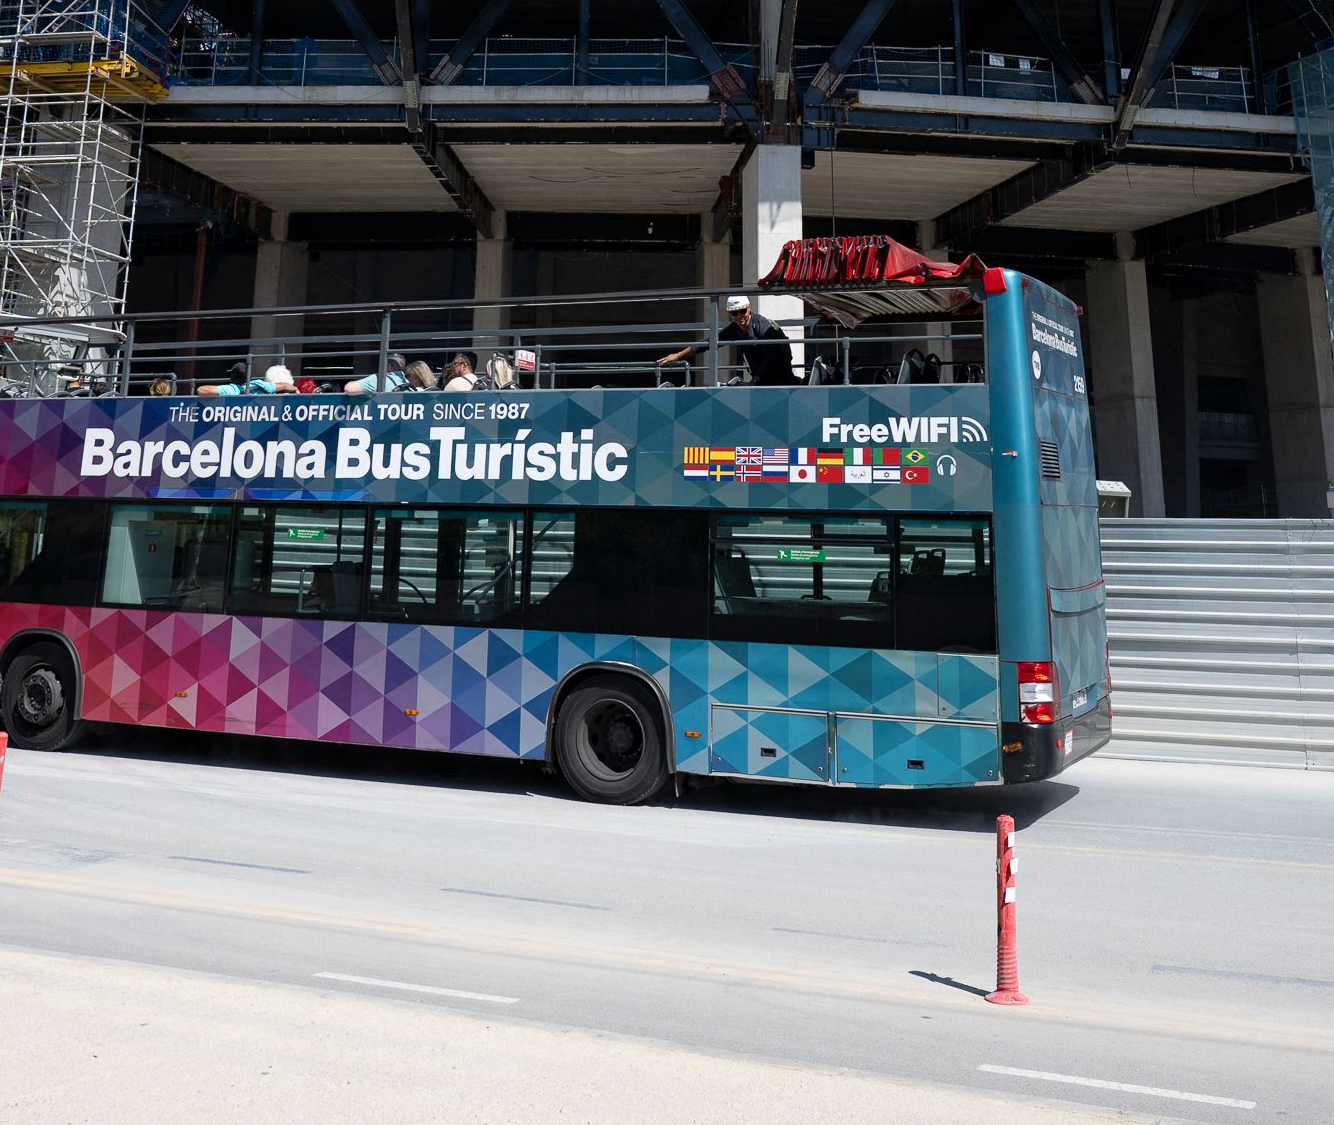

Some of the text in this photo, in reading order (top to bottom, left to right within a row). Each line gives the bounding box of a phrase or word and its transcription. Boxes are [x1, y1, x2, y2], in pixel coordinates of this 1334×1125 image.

[169, 403, 530, 423] THE ORIGINAL & OFFICIAL TOUR SINCE 1987
[80, 427, 328, 479] Barcelona
